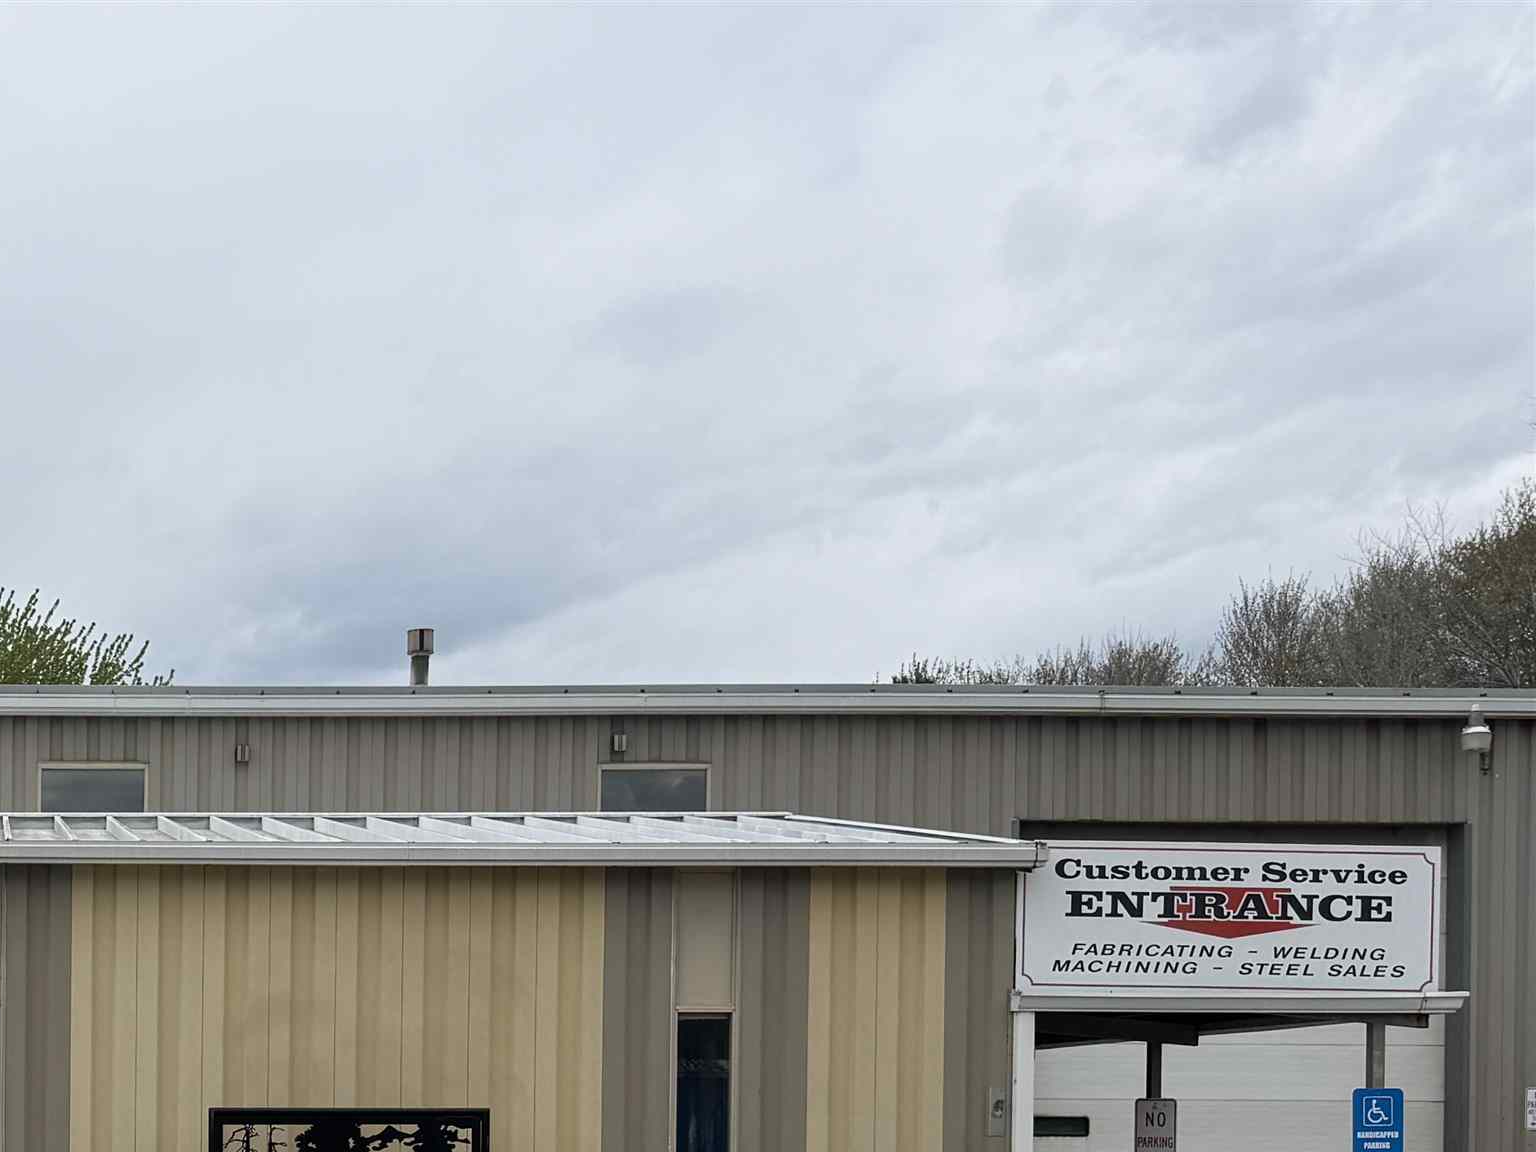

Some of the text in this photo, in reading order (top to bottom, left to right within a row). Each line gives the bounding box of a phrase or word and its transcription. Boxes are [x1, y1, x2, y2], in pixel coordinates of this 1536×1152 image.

[1054, 857, 1408, 885] Customer Service
[1065, 890, 1393, 922] ENTRANCE
[1071, 943, 1233, 958] FABRICATING
[1274, 946, 1386, 961] WELDING
[1052, 959, 1198, 974] MACHINING
[1239, 963, 1315, 977] STEEL
[1328, 963, 1406, 978] SALES
[1145, 1112, 1166, 1127] NO
[1137, 1137, 1173, 1148] PARKING
[1364, 1141, 1391, 1150] PARKING
